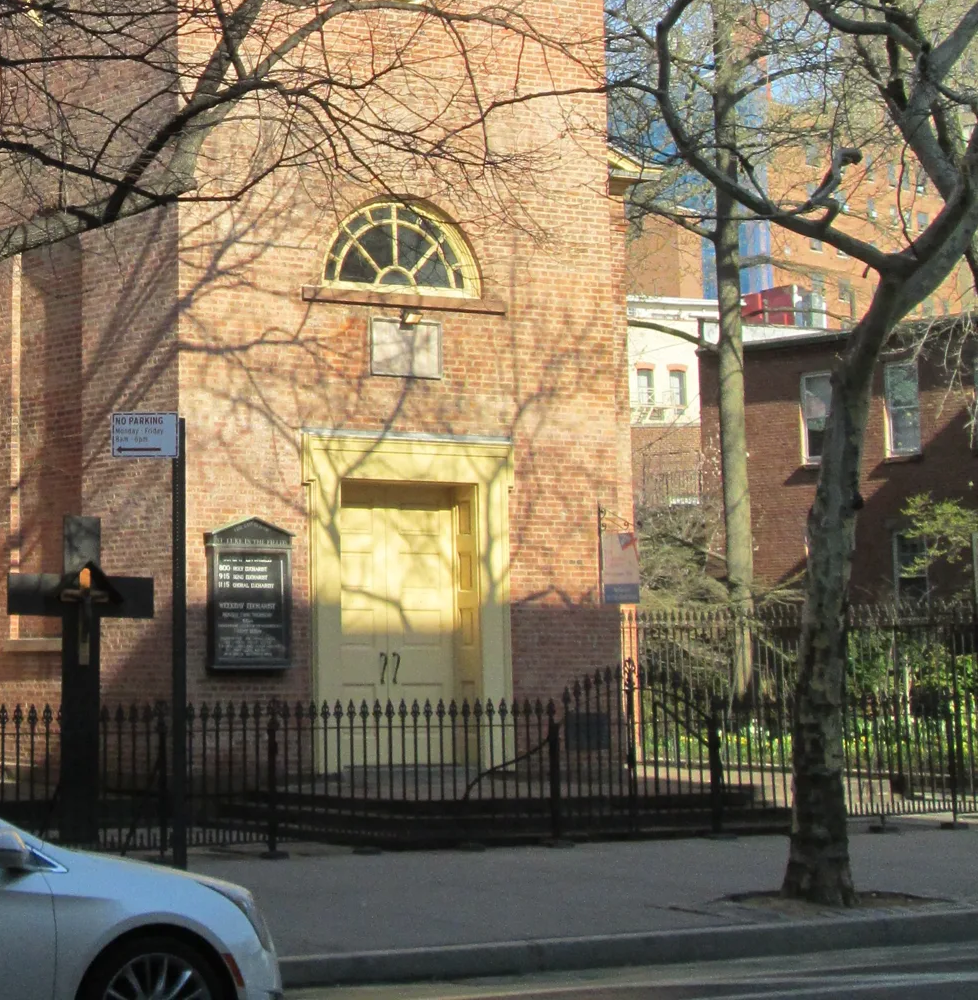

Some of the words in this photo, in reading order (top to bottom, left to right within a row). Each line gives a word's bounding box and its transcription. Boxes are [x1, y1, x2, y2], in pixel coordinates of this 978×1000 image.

[115, 417, 127, 425] NO
[128, 417, 164, 425] PARKING
[144, 427, 164, 435] Friday
